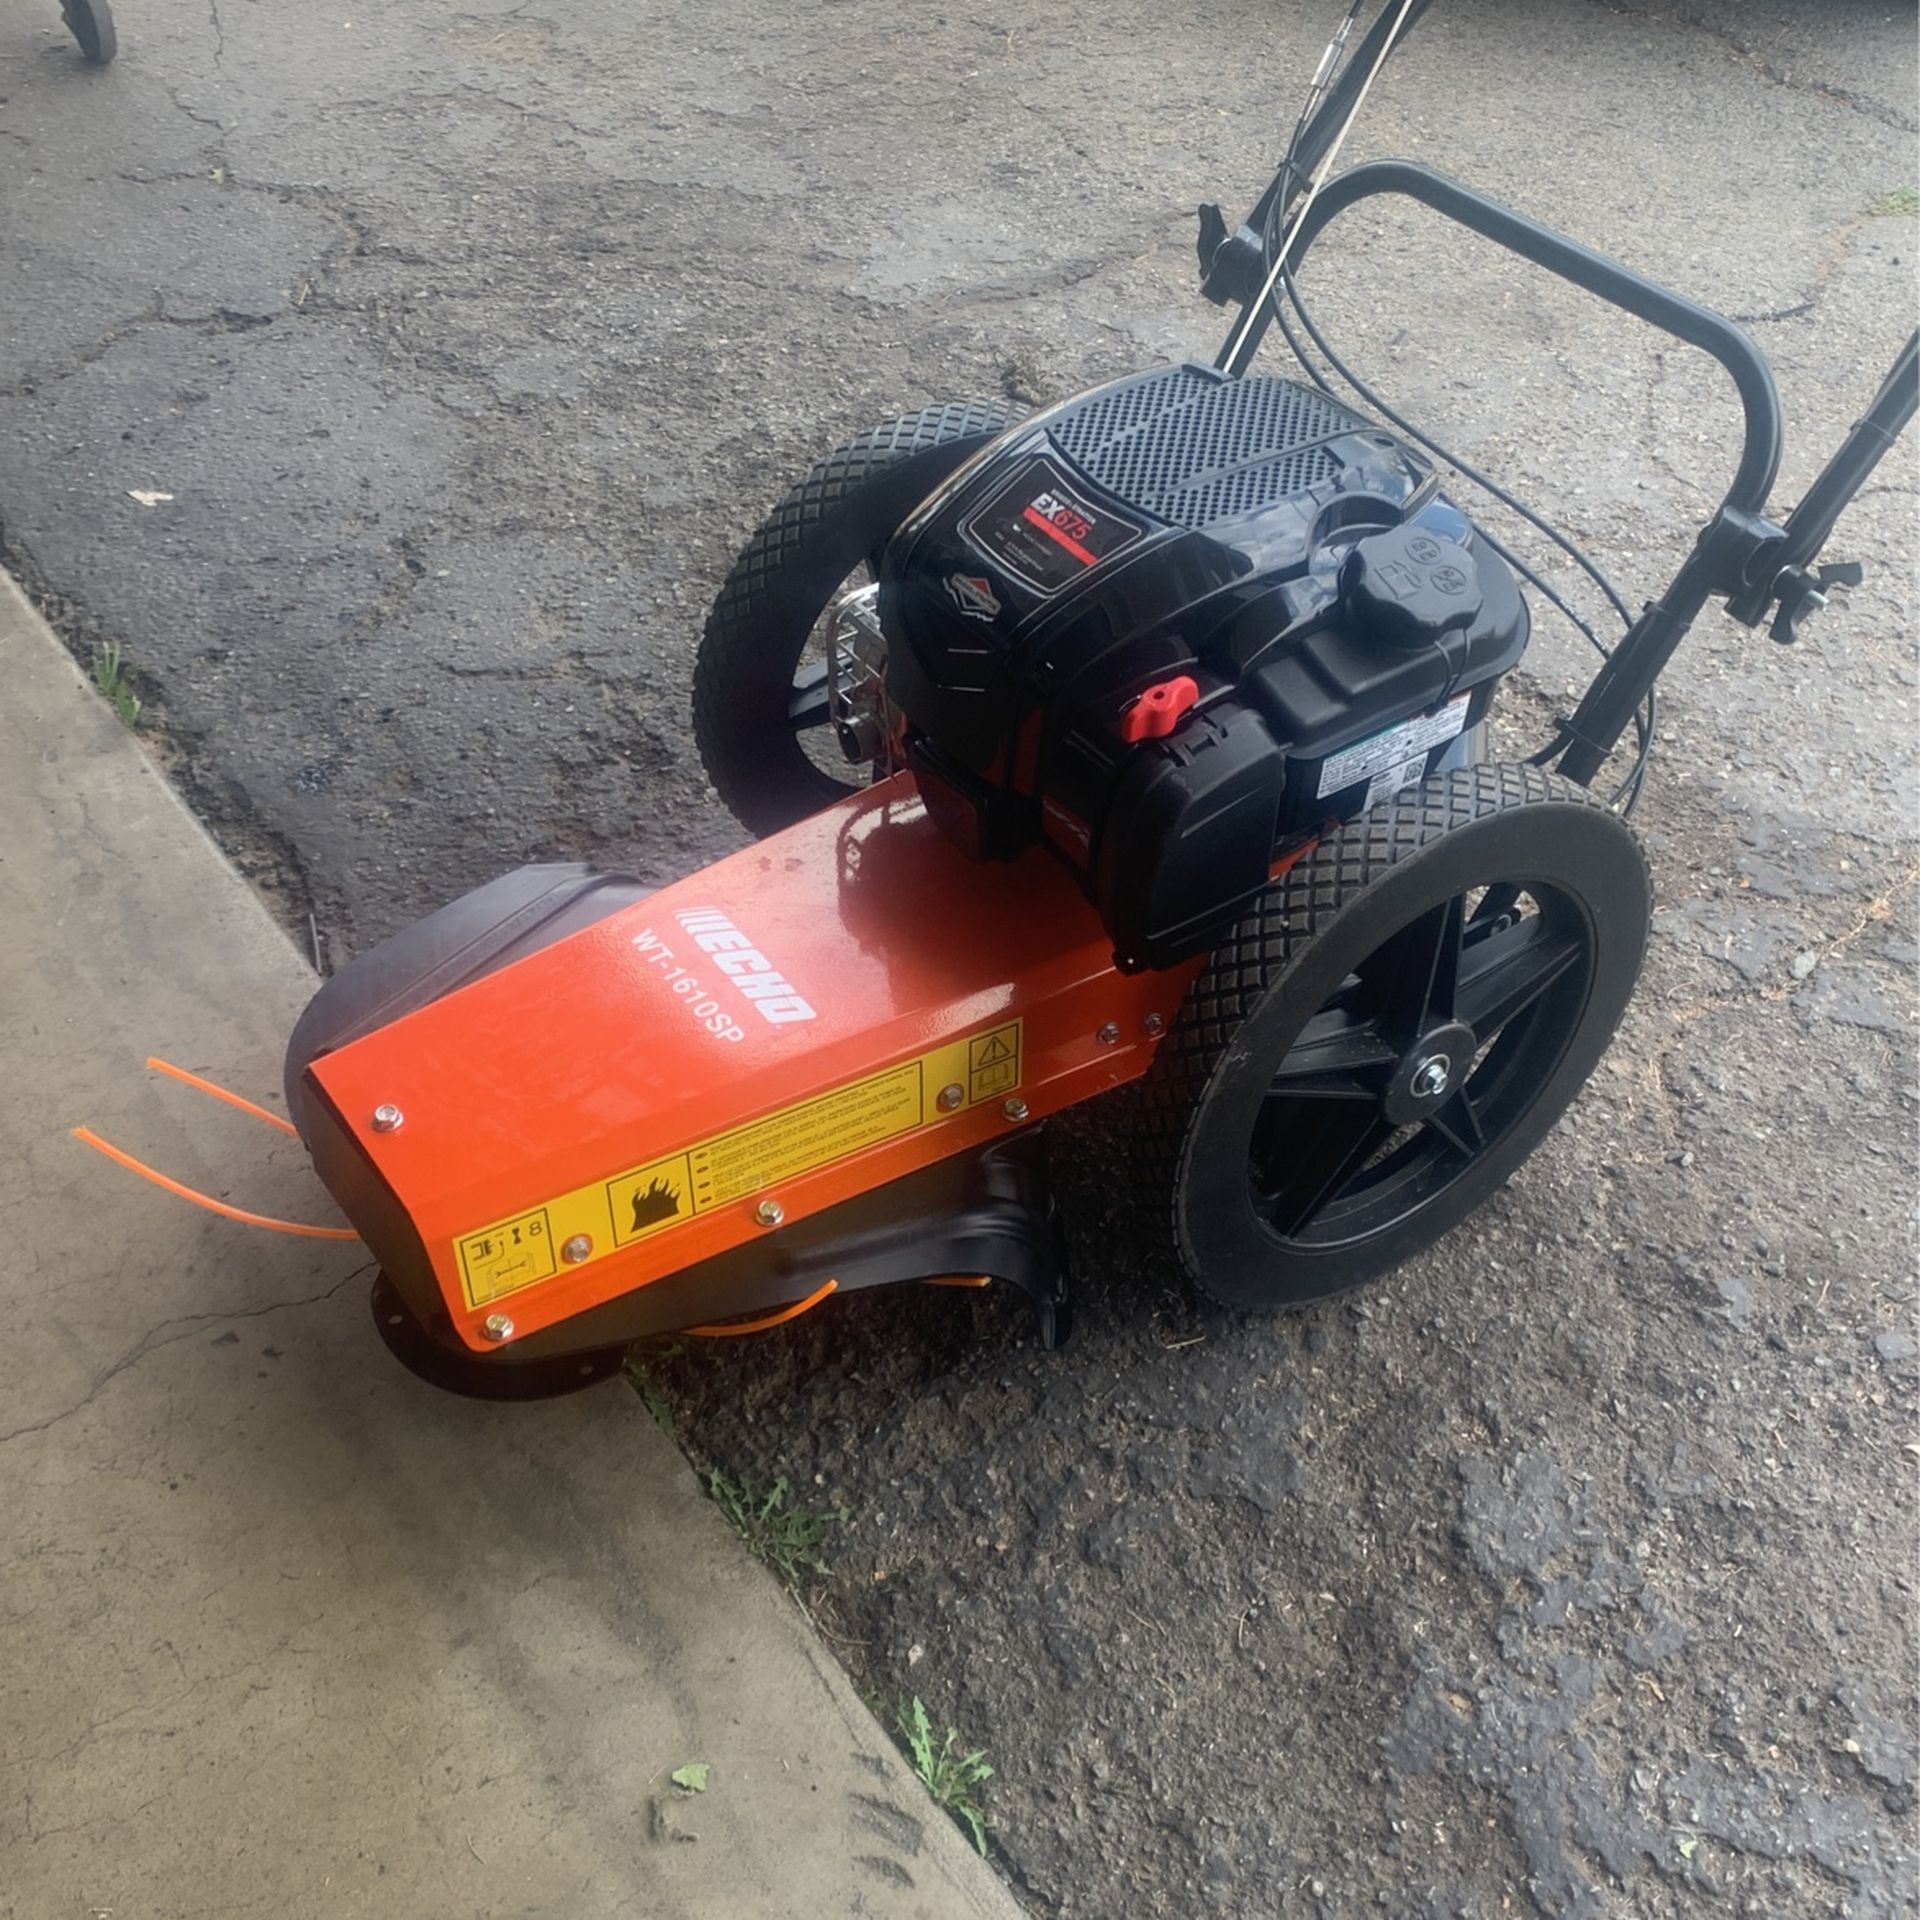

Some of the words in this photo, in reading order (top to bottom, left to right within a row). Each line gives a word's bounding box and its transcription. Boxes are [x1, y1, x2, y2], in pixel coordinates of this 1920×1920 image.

[1030, 492, 1092, 540] EX675
[631, 928, 745, 1042] WT-1610SP
[693, 929, 818, 1024] ECHO
[528, 1220, 543, 1237] 8
